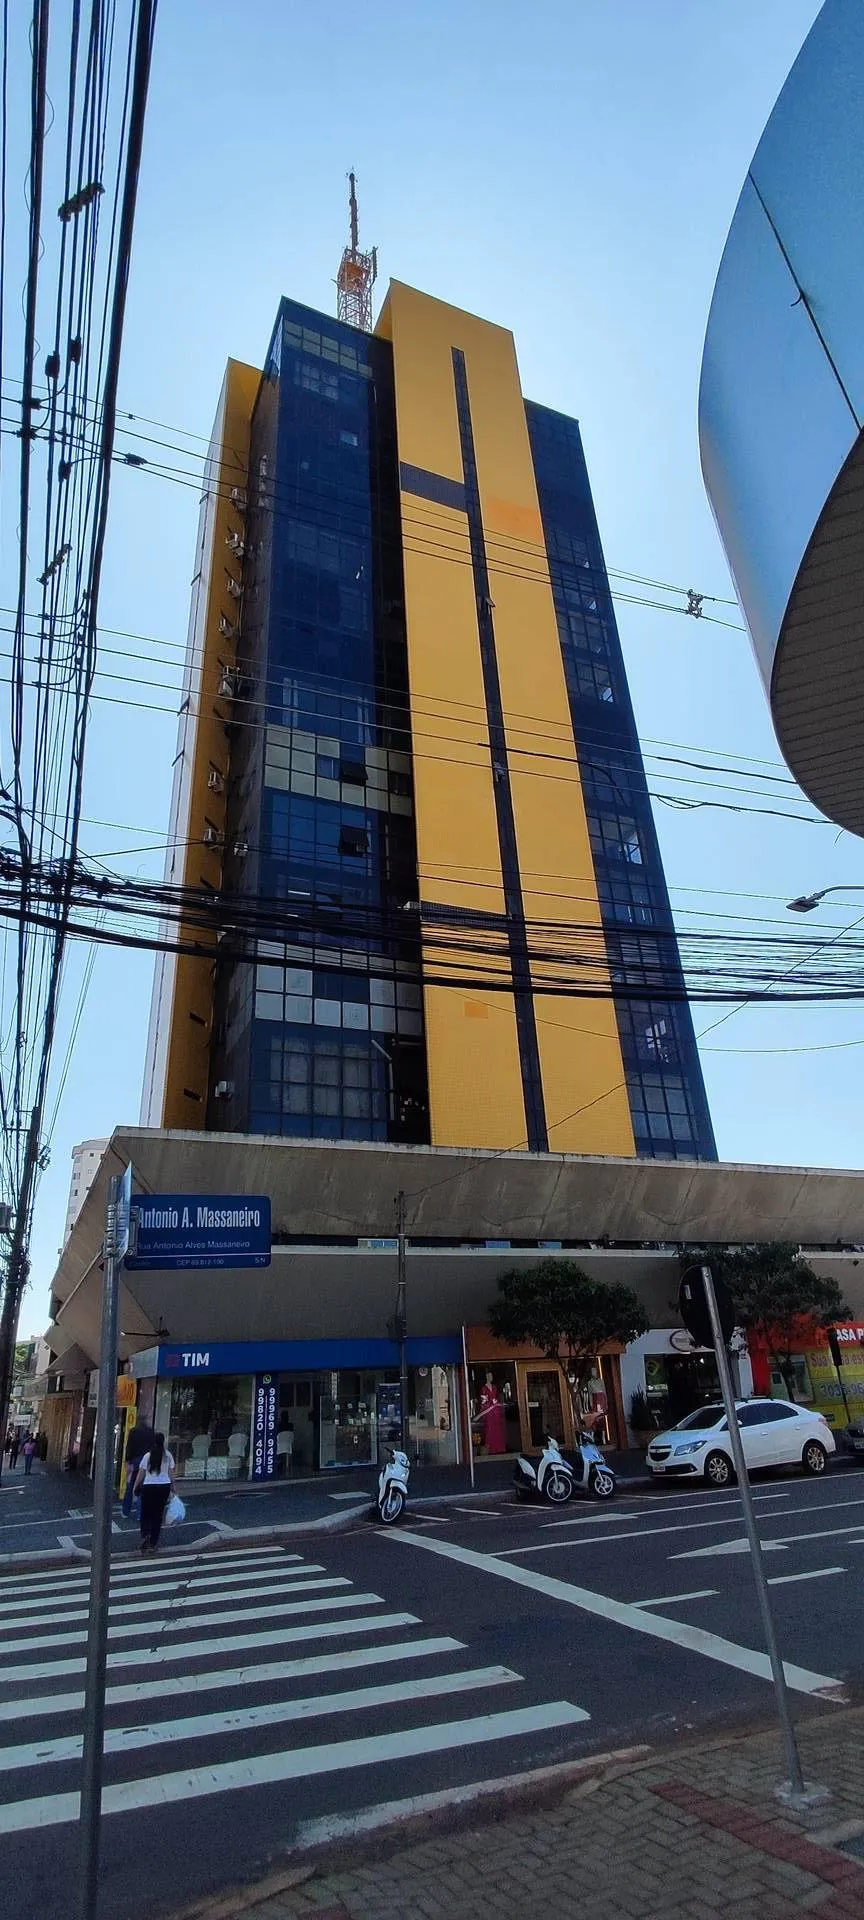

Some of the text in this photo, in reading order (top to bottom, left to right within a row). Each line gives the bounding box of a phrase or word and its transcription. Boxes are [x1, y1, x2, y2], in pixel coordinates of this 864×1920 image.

[138, 1207, 260, 1229] Antonio A. Massaneiro
[153, 1242, 183, 1250] Antonio
[185, 1241, 205, 1250] Alves
[207, 1240, 250, 1249] Massaneiro
[836, 1328, 857, 1341] ASA
[182, 1352, 210, 1367] TIM
